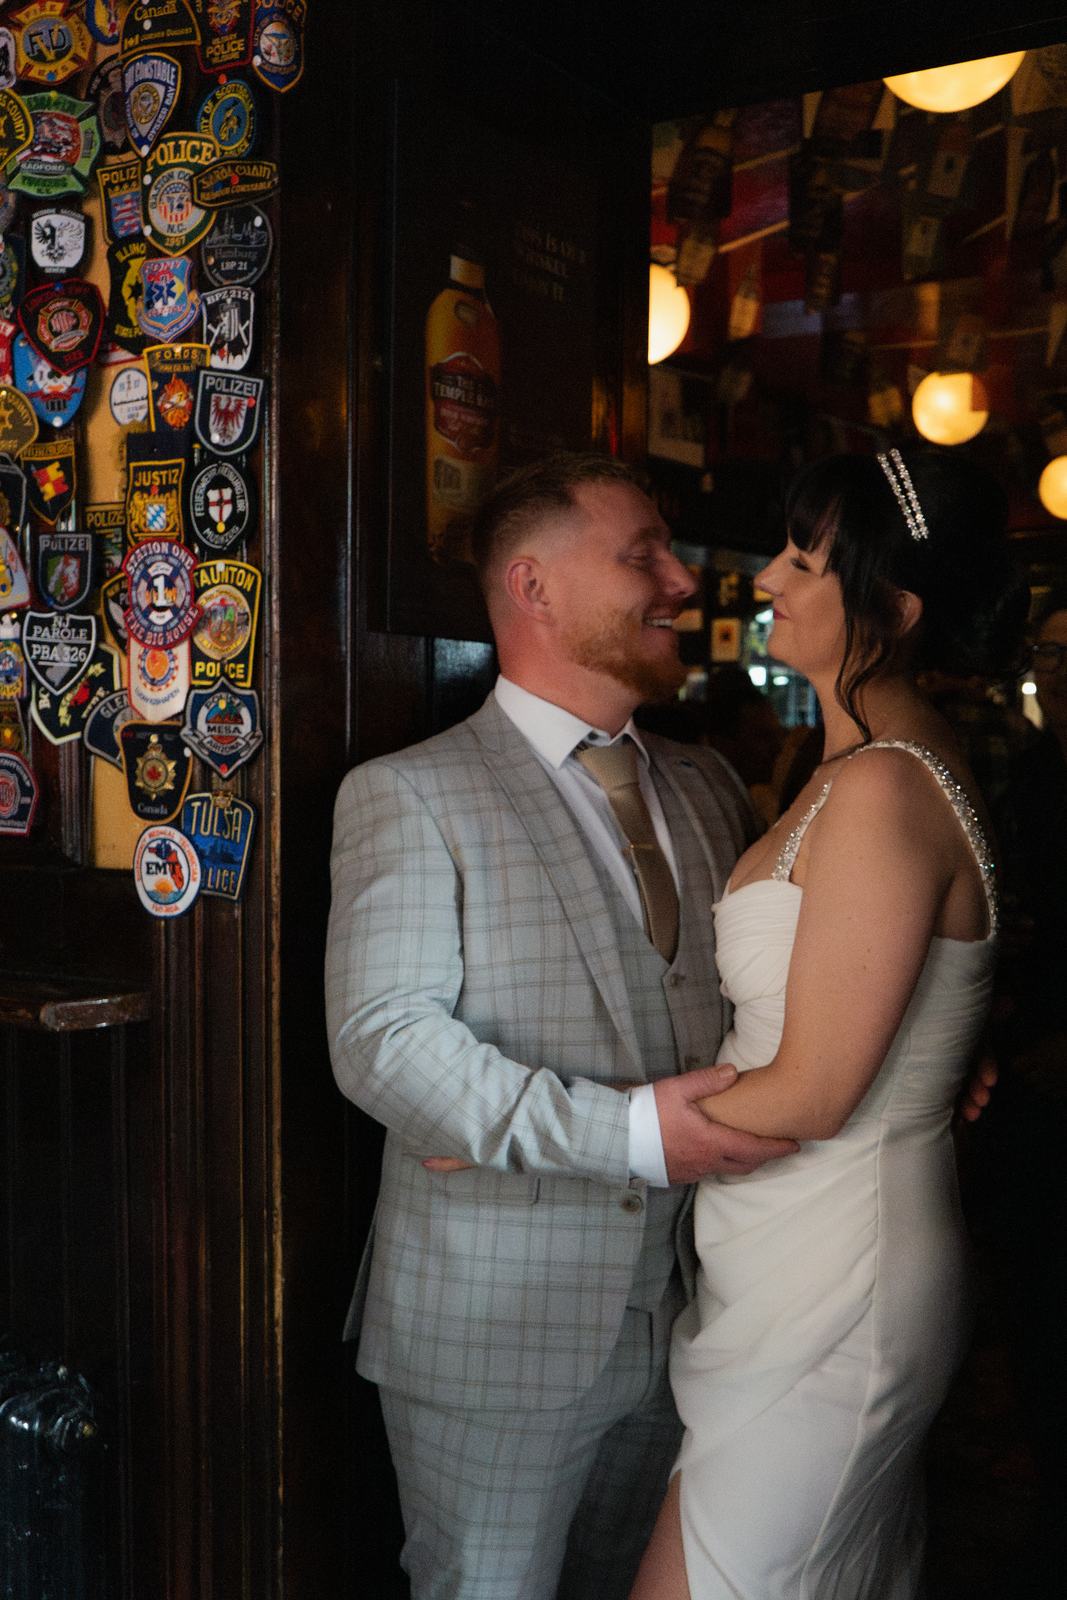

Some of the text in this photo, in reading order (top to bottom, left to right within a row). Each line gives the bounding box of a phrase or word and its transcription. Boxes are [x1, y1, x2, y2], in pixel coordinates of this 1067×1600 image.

[206, 38, 246, 58] POLICE
[101, 167, 139, 186] POLIZ
[205, 376, 257, 397] POLIZEI
[134, 469, 179, 487] JUSTIZ
[86, 510, 126, 529] POLIZE
[43, 537, 91, 552] POLIZEI
[153, 574, 176, 608] 1
[32, 625, 88, 641] PAROLE
[31, 643, 60, 661] PBA
[206, 725, 243, 734] MESA
[191, 801, 242, 843] TULSA
